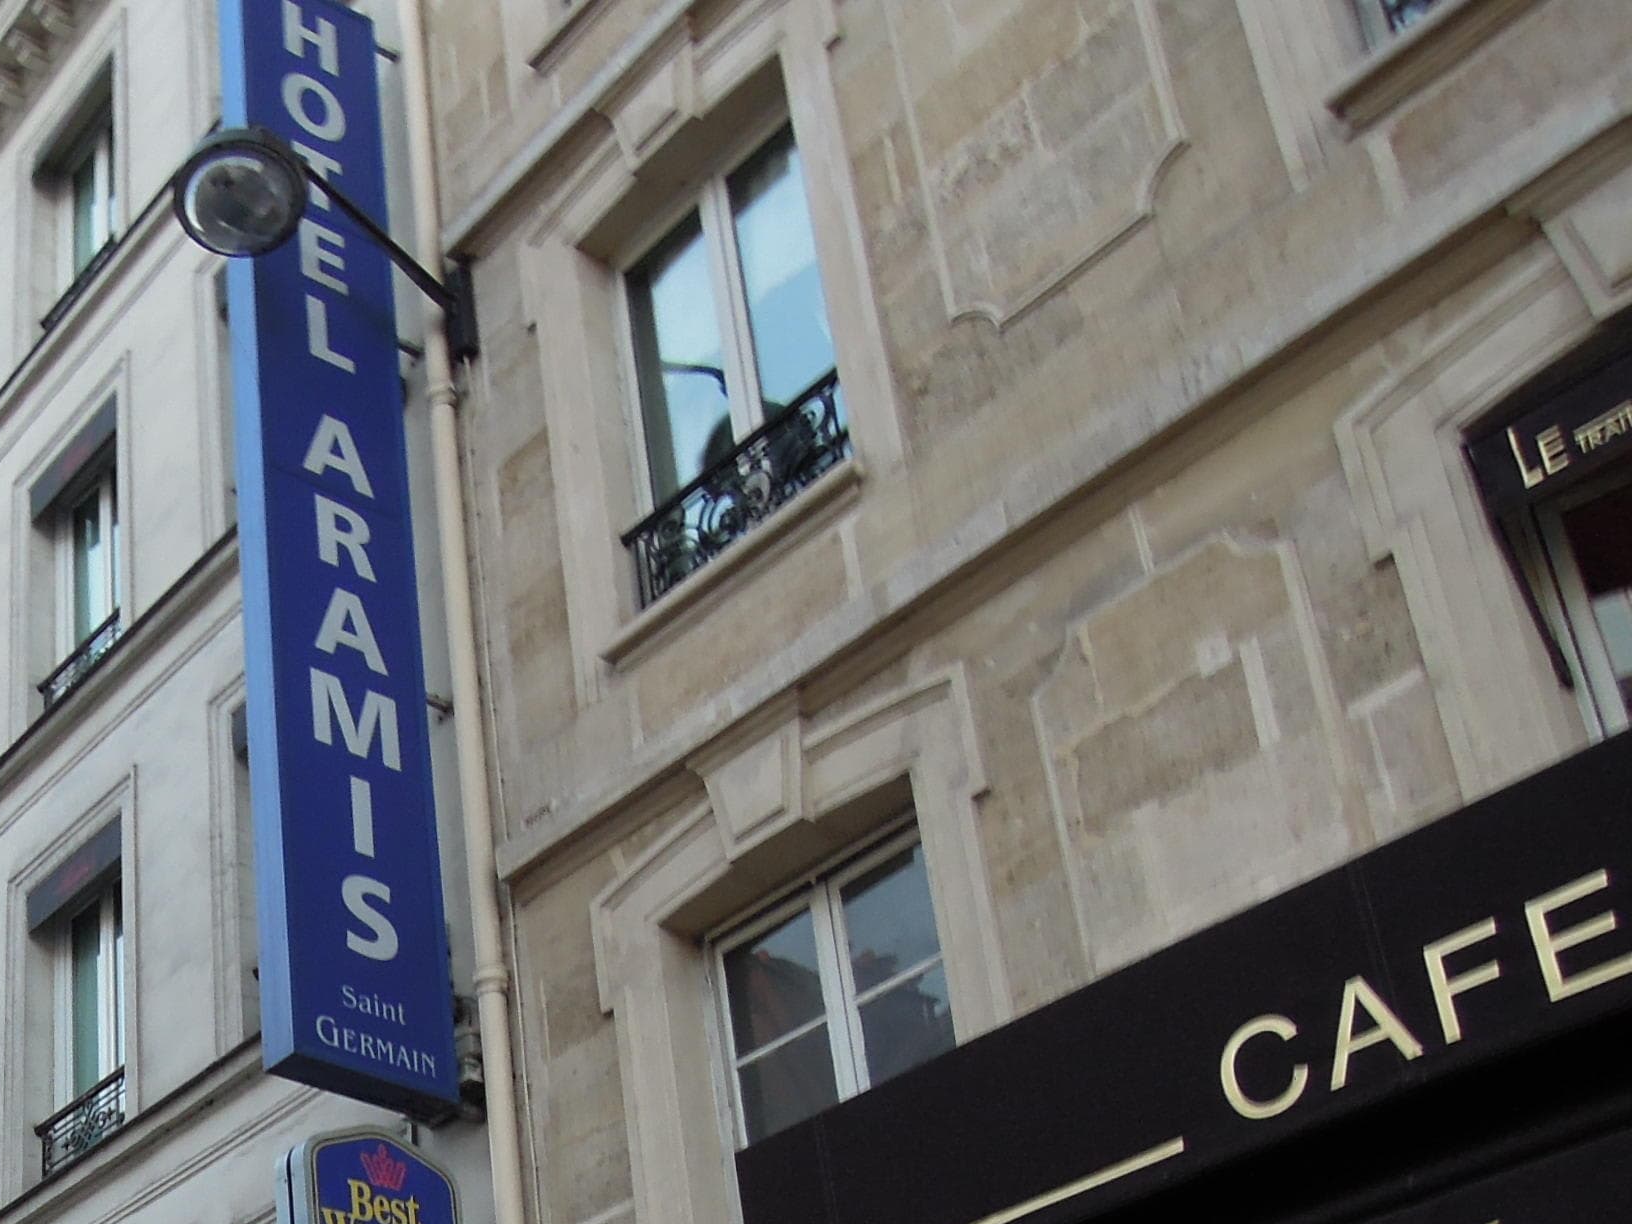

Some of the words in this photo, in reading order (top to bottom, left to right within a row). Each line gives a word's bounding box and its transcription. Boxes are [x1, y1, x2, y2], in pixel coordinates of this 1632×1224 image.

[280, 0, 357, 375] HOTEL
[1506, 424, 1569, 490] LE
[302, 412, 402, 962] ARAMIS
[315, 1014, 437, 1080] GERMAIN
[341, 984, 407, 1026] Saint
[1219, 868, 1632, 1120] CAFE
